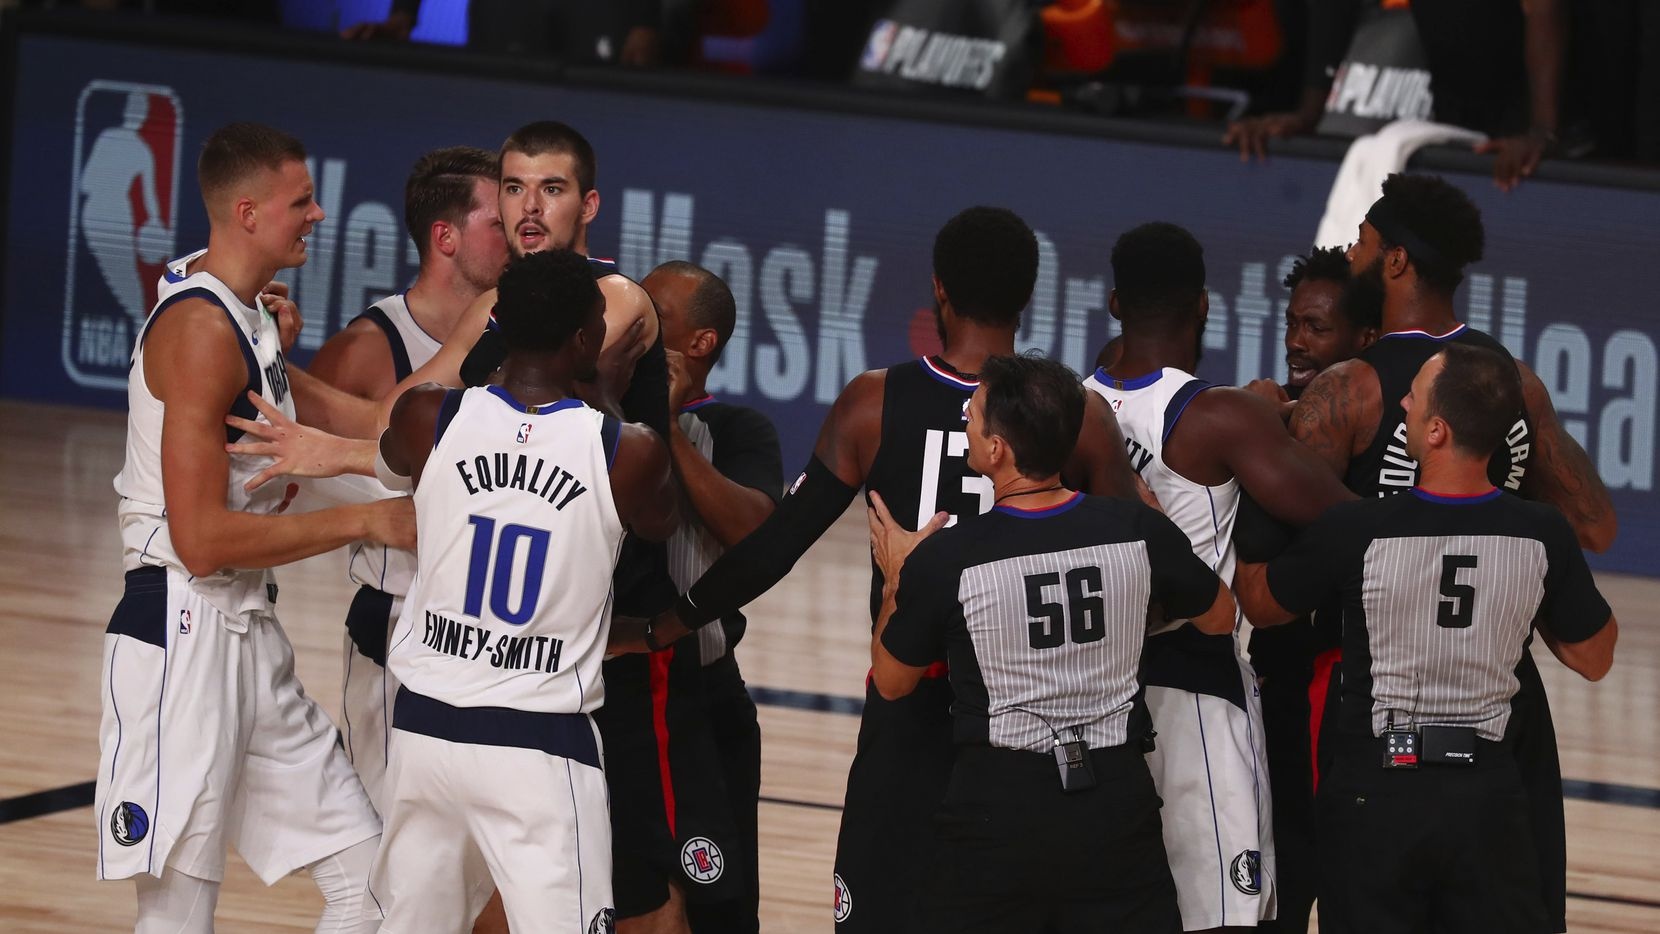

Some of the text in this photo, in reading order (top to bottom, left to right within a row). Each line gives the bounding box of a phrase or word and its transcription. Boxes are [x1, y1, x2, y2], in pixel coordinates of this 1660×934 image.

[456, 453, 587, 511] EQUALITY
[917, 428, 995, 532] 13
[463, 514, 552, 626] 10
[1024, 566, 1105, 650] 56
[1437, 555, 1477, 628] 5
[422, 609, 564, 674] FINNEY-SMITH
